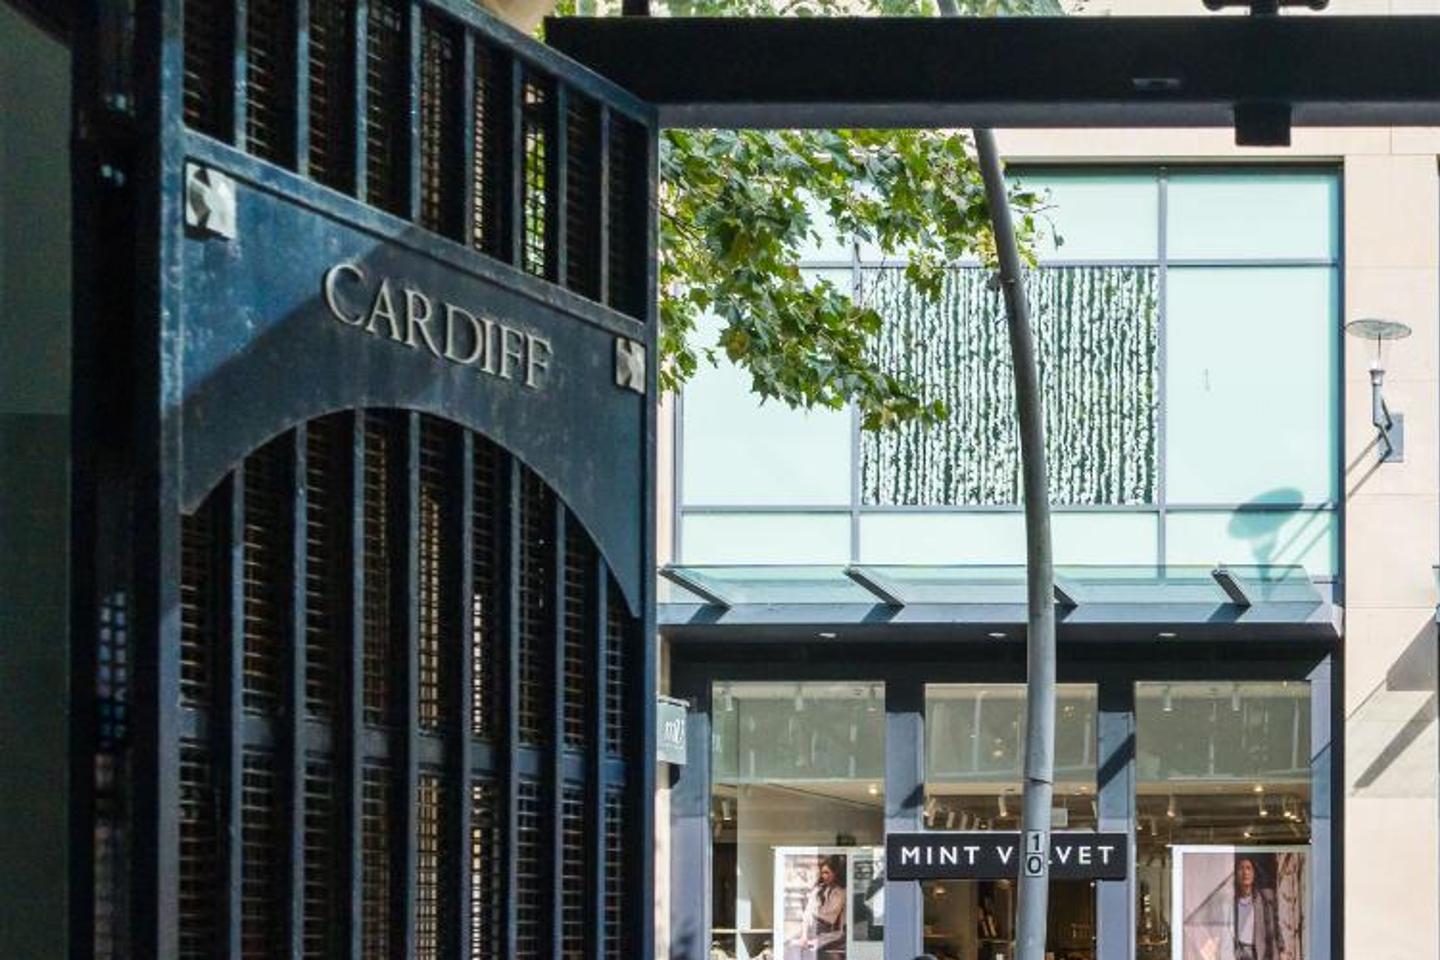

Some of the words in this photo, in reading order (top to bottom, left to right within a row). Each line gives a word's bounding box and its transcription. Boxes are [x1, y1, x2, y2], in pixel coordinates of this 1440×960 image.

[325, 263, 554, 389] CARDIFF
[901, 846, 980, 865] MINT
[996, 846, 1114, 865] VVET
